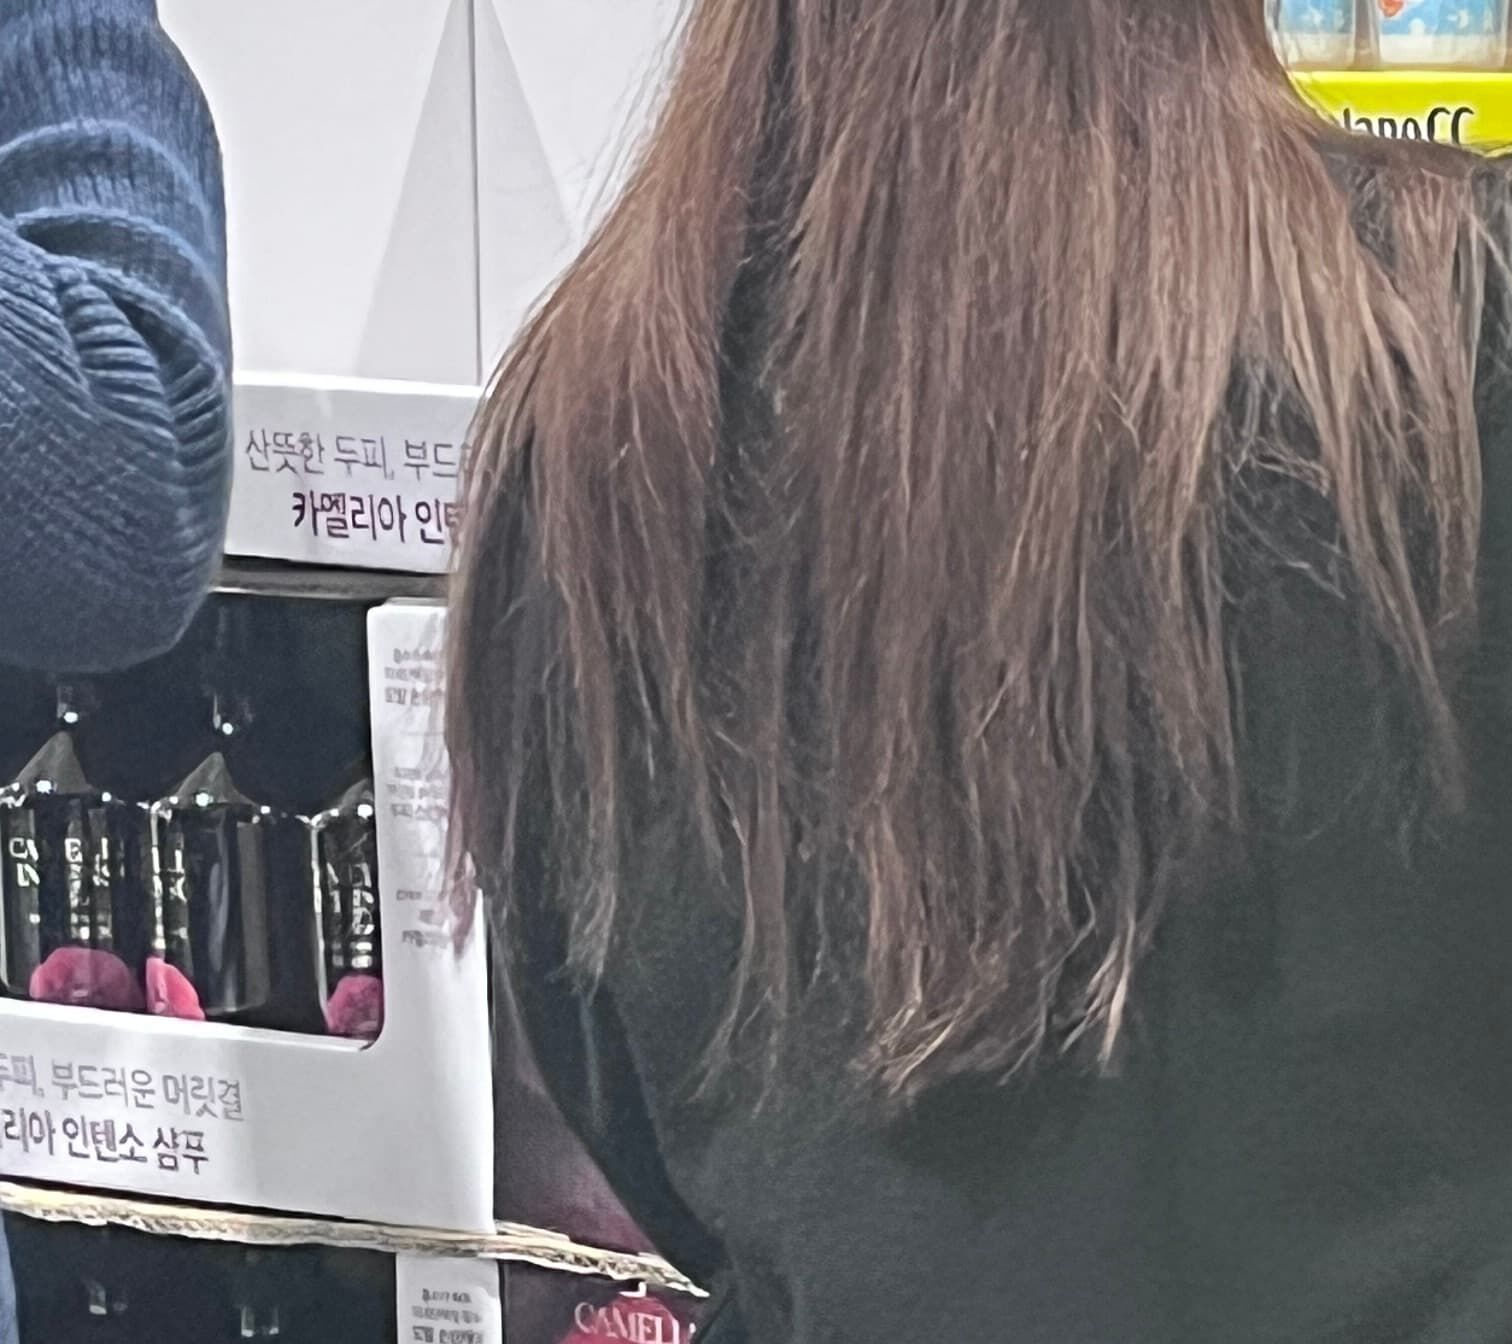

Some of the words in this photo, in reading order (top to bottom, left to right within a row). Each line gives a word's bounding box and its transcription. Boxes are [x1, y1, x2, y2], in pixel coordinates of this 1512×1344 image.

[403, 439, 459, 481] 부드
[50, 1060, 156, 1110] 부드러운
[161, 1072, 246, 1122] 머릿결
[0, 1107, 57, 1158] 리아
[152, 1126, 209, 1175] 샴푸
